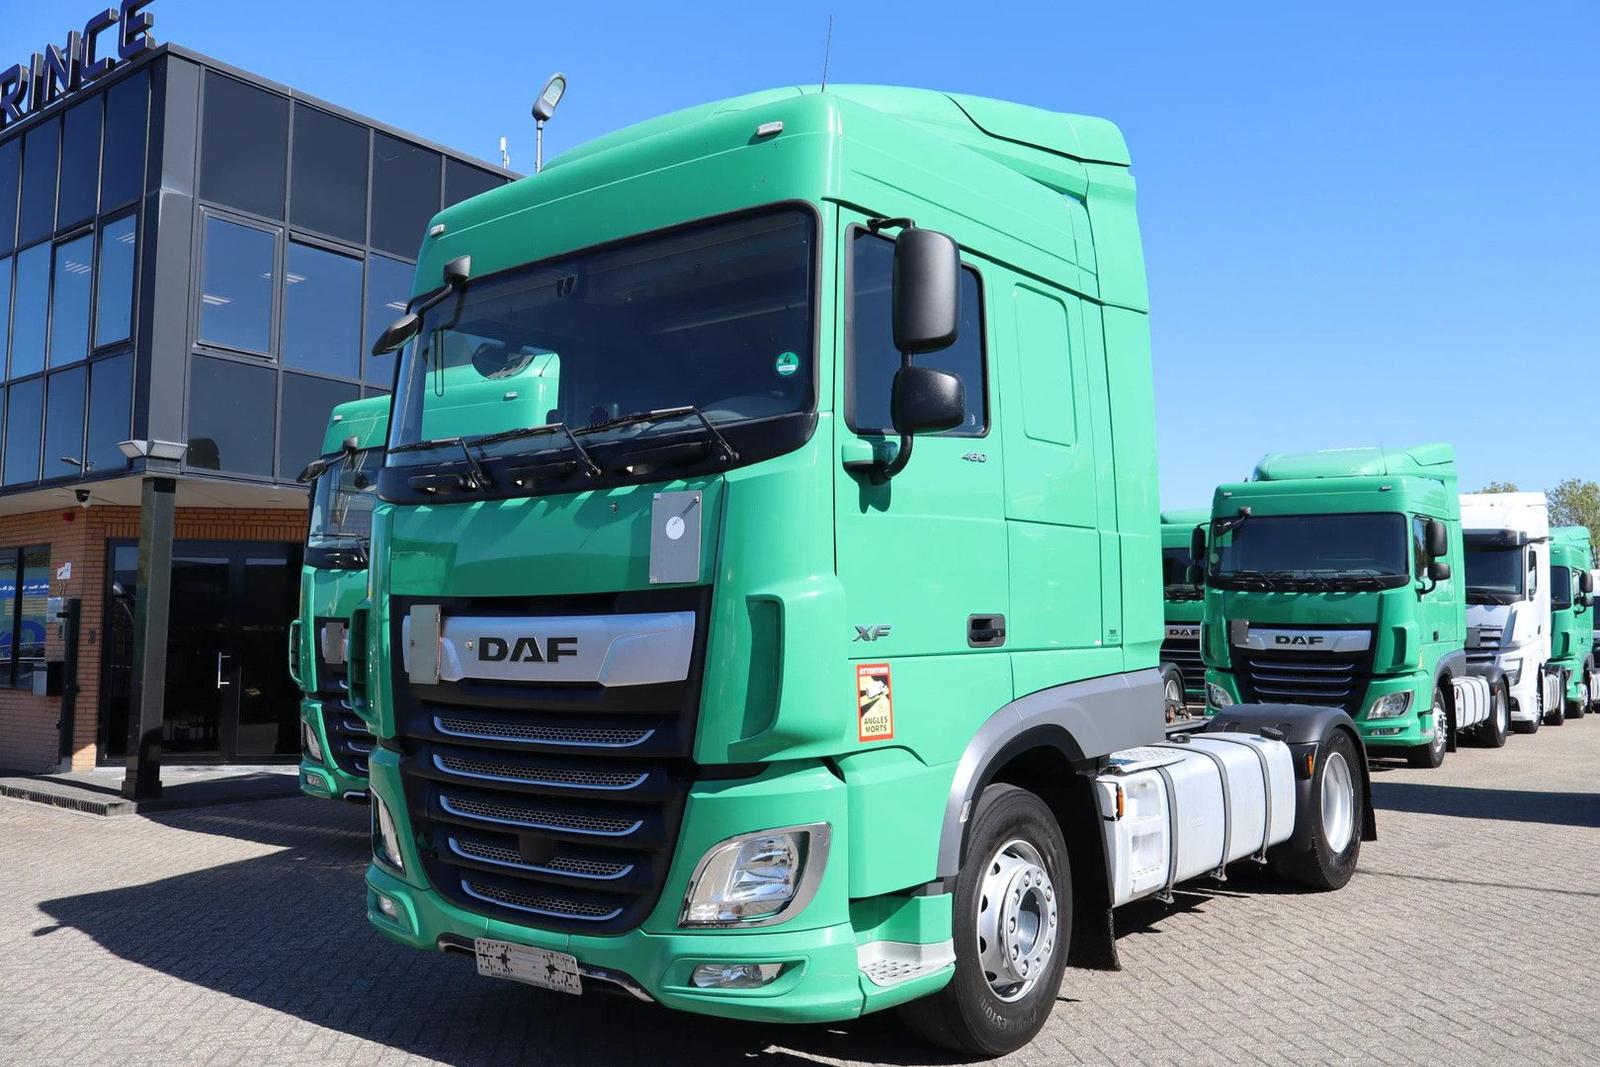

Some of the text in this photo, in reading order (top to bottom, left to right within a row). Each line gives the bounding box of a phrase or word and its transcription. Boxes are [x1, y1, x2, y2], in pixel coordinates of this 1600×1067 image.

[852, 625, 891, 642] XF
[1275, 635, 1323, 645] DAF
[479, 636, 578, 662] DAF
[864, 716, 888, 725] ANGLES
[865, 724, 888, 733] MORTS
